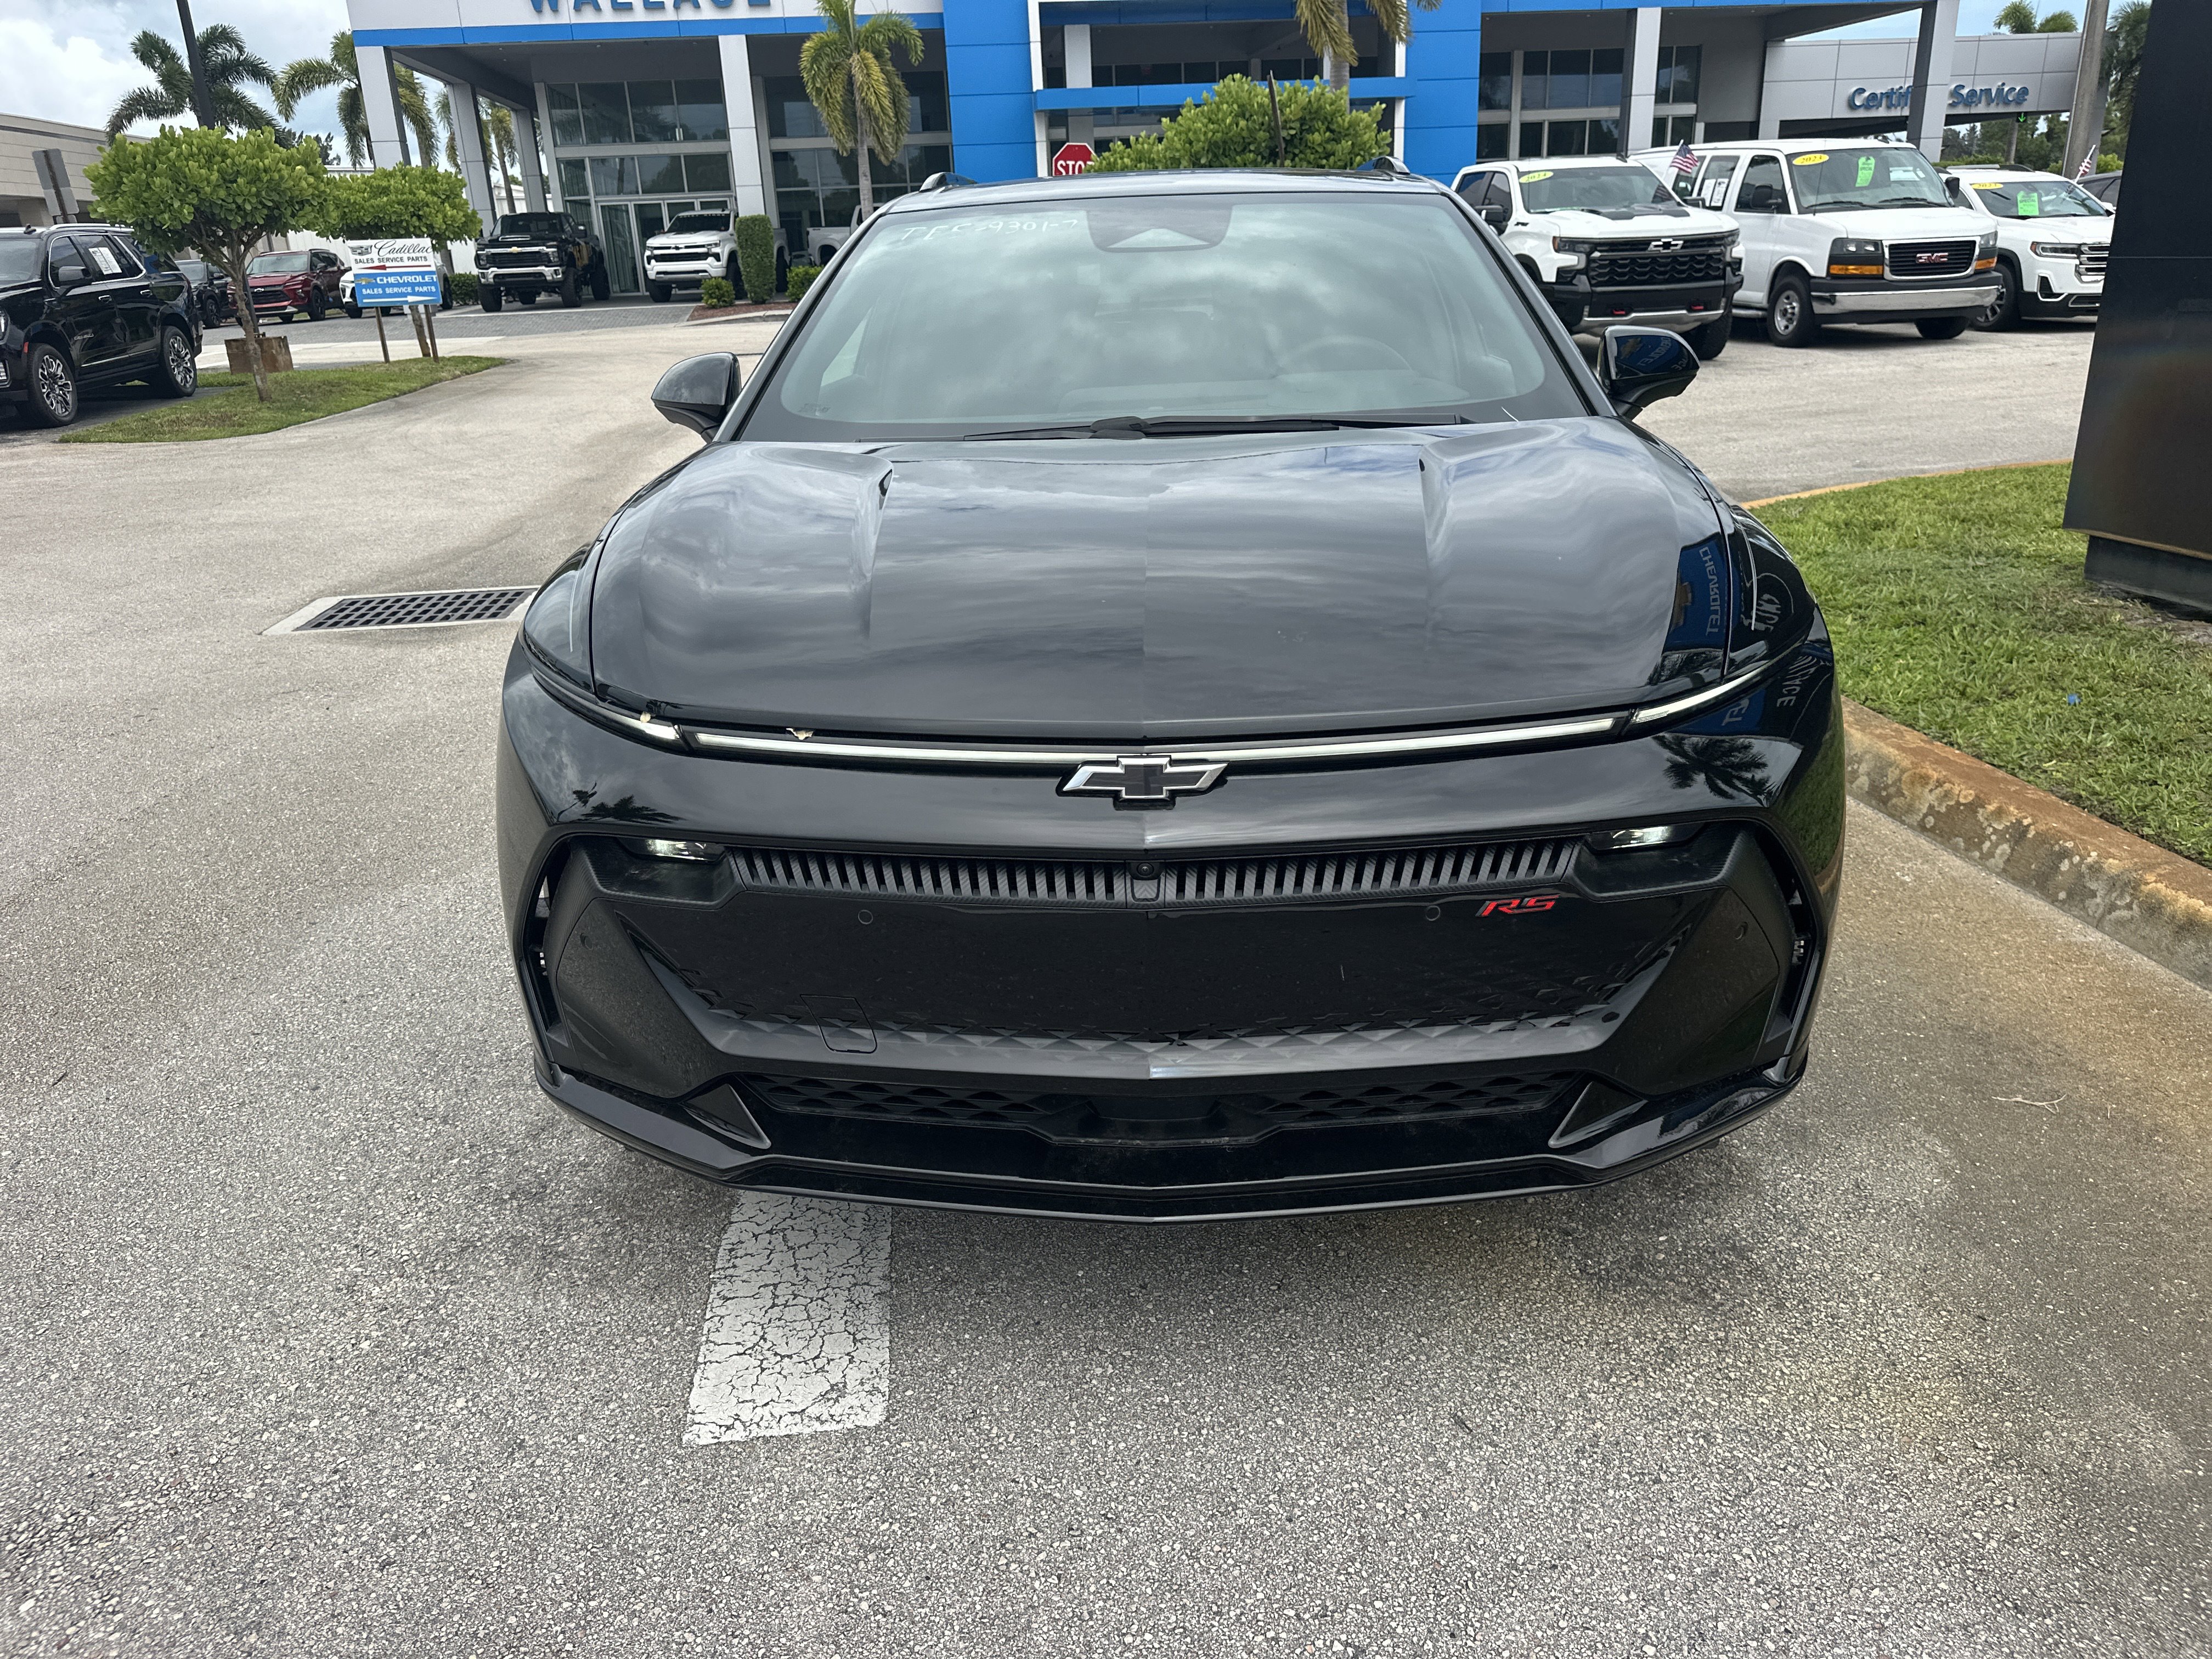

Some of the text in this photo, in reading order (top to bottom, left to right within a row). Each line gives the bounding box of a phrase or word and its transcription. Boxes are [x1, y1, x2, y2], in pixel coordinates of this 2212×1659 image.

[1851, 82, 2029, 109] Certif Service
[1057, 160, 1095, 176] STO
[374, 240, 432, 257] Cadillac
[1915, 252, 1949, 264] GMC
[377, 275, 437, 284] CHEVROLET
[1475, 894, 1560, 917] RS
